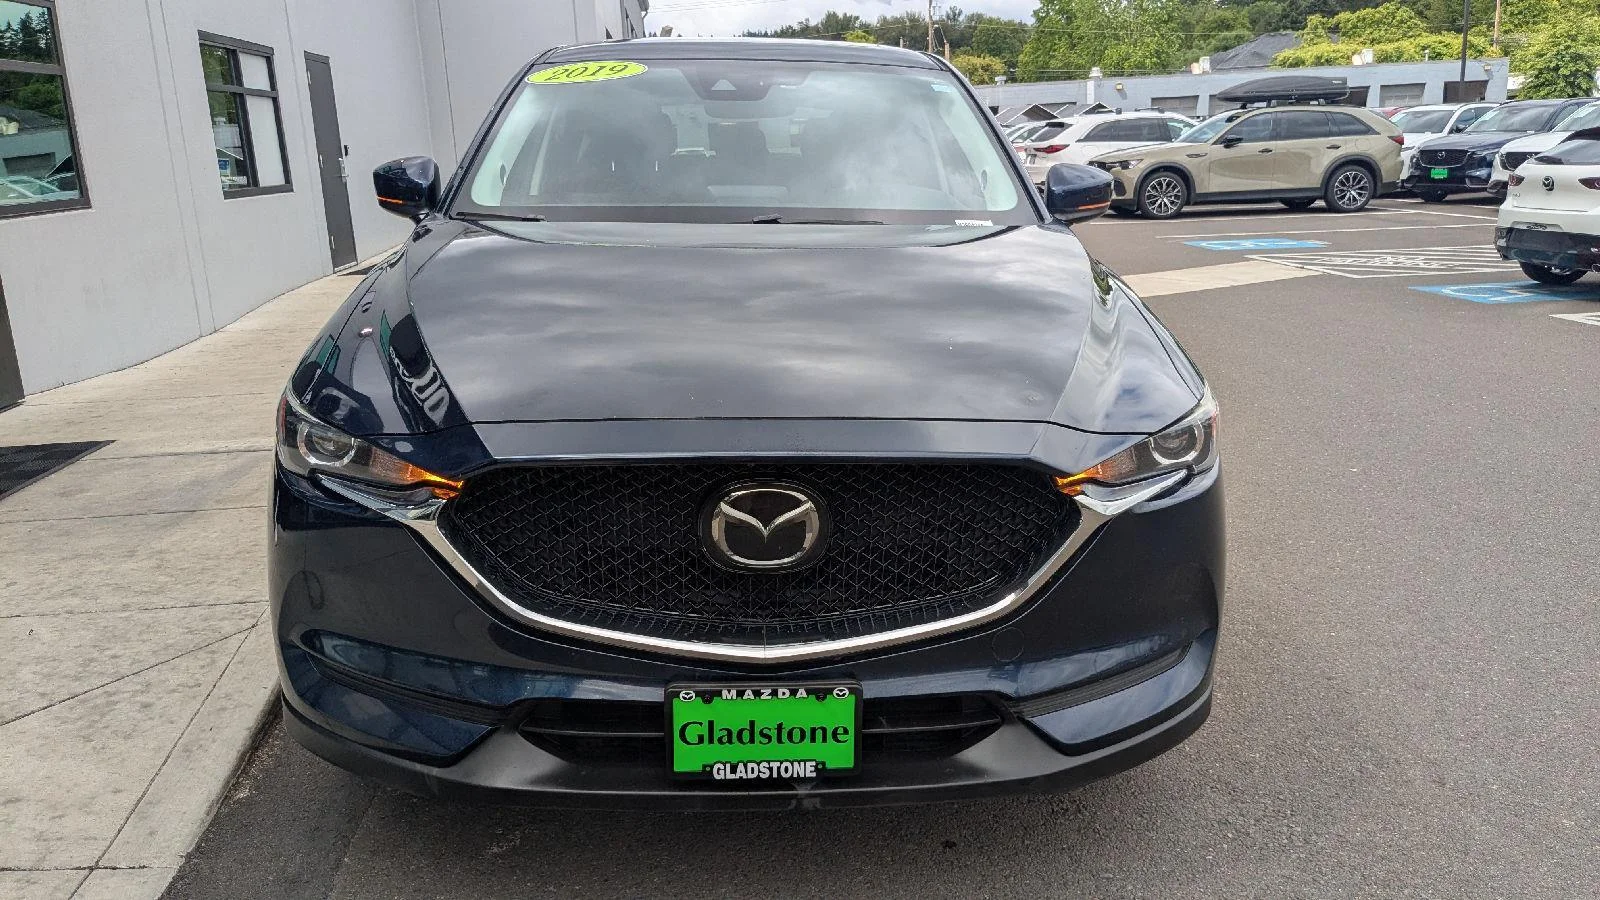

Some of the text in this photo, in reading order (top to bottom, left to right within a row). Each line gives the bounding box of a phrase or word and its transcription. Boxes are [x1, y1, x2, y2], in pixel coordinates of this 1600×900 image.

[544, 64, 629, 82] 2019
[721, 688, 808, 700] MAZDA
[678, 719, 850, 746] Gladstone
[712, 761, 817, 780] GLADSTONE
